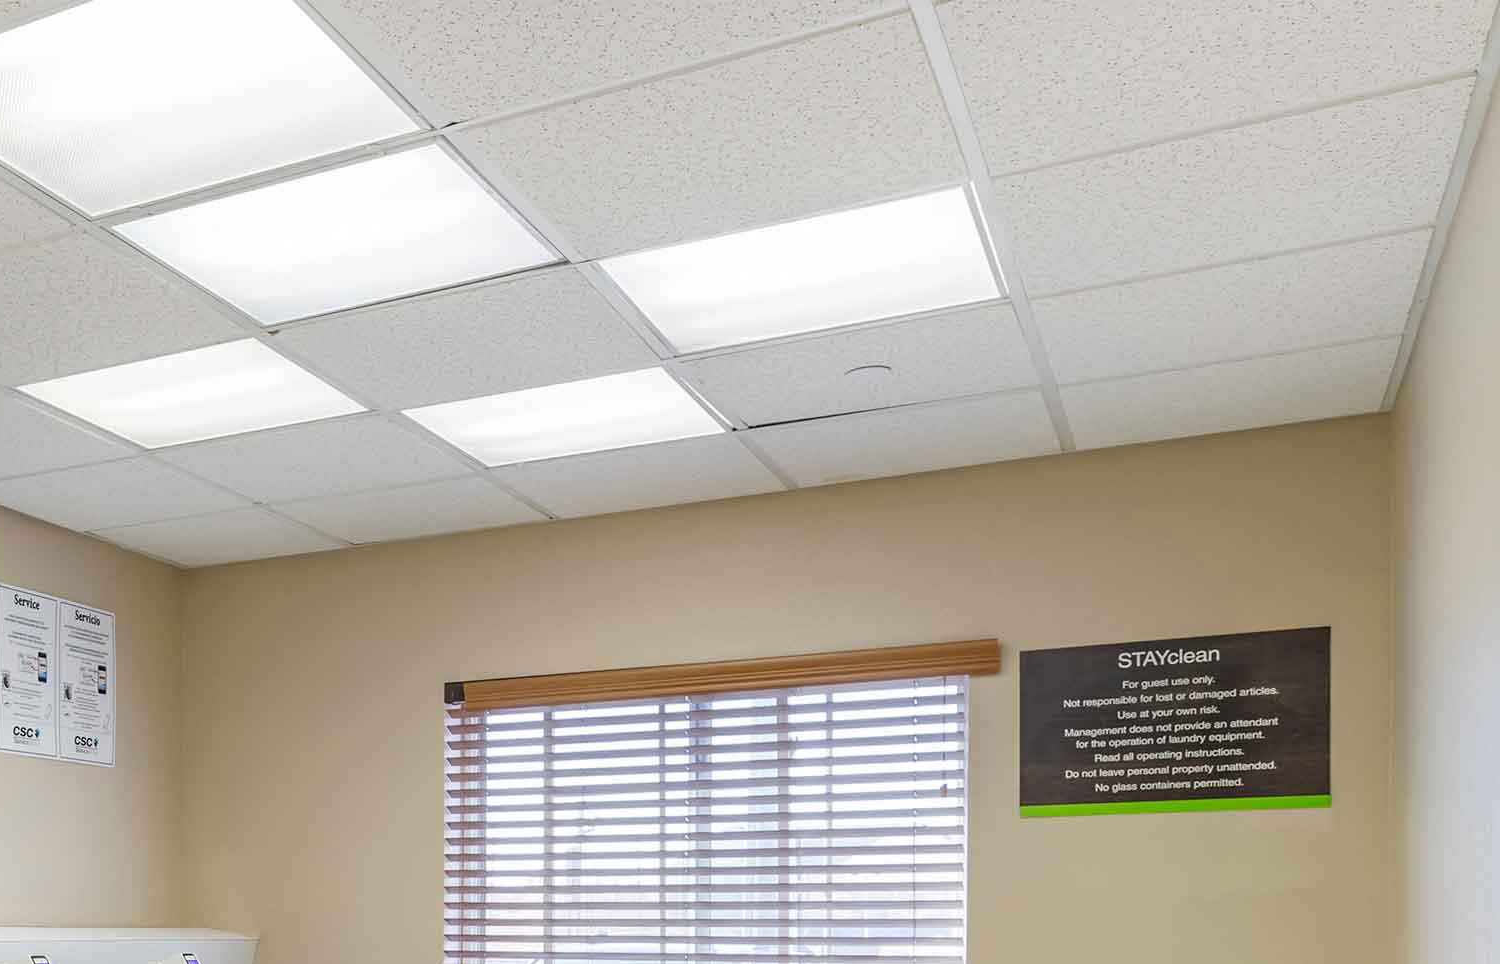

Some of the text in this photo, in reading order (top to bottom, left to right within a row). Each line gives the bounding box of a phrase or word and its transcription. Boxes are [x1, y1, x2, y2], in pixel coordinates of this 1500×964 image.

[14, 594, 40, 610] Service
[75, 610, 100, 626] Servicio
[1118, 648, 1220, 668] STAYclean
[1122, 675, 1216, 690] For guest use only.
[1063, 686, 1280, 708] Not responsible for lost or damaged articles.
[1117, 705, 1221, 720] Use at your own risk.
[13, 726, 34, 738] CSC
[1064, 717, 1279, 738] Management does not provide an attendant
[74, 736, 93, 747] CSC
[1075, 731, 1266, 749] for the operation of laundry equipment.
[1094, 748, 1245, 763] Read all operating instructions.
[1065, 760, 1277, 779] Do not leave personal property unattended.
[1094, 778, 1245, 793] No glass containers permitted.
